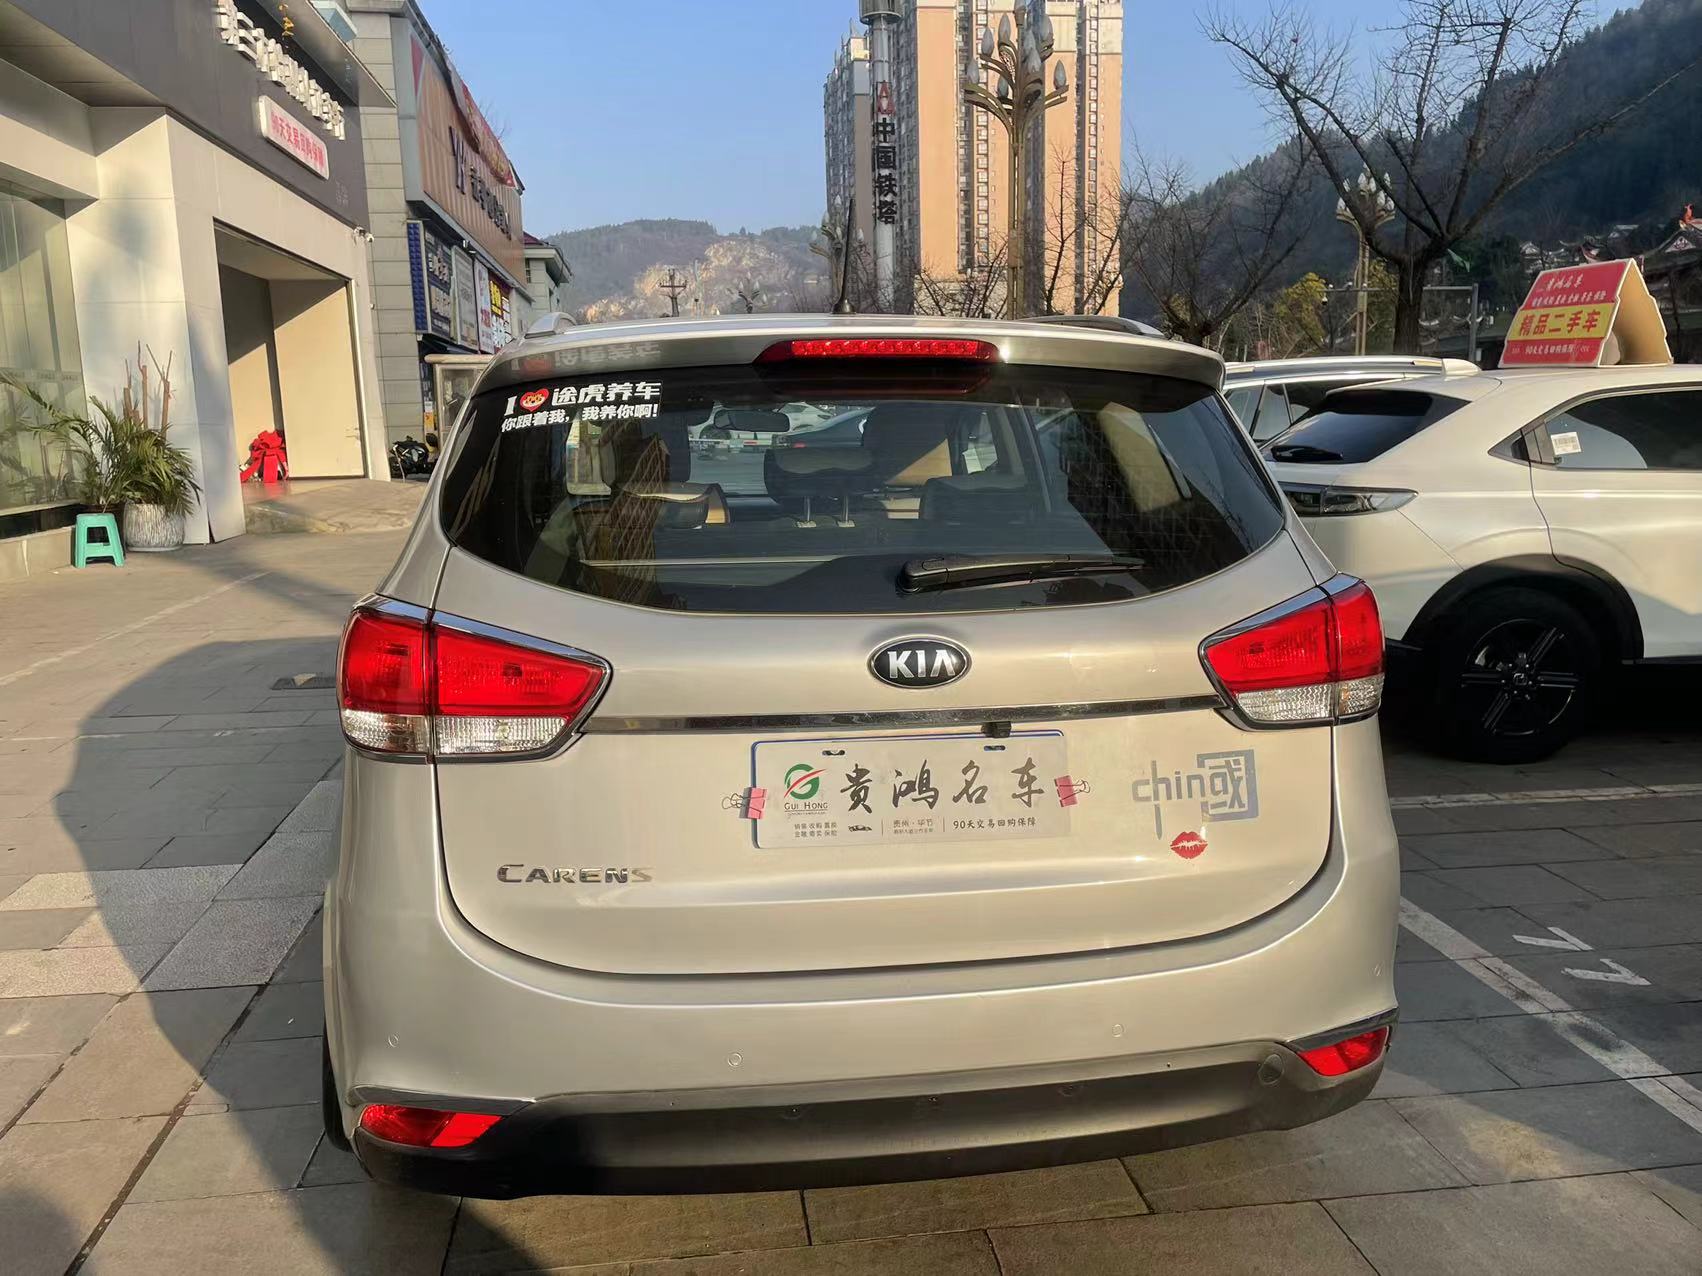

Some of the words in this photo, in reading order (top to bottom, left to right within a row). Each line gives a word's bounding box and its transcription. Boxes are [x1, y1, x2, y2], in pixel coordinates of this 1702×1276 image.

[875, 117, 897, 224] 中国铁塔
[1520, 309, 1600, 336] 精品二手车
[552, 382, 662, 406] 途虎养车
[887, 649, 956, 679] KIA
[839, 757, 1045, 813] 贵鸿名车
[784, 802, 799, 810] GUI
[804, 801, 828, 809] HONG
[953, 817, 1037, 830] 90天交易回购保障
[497, 864, 653, 883] CARENS
